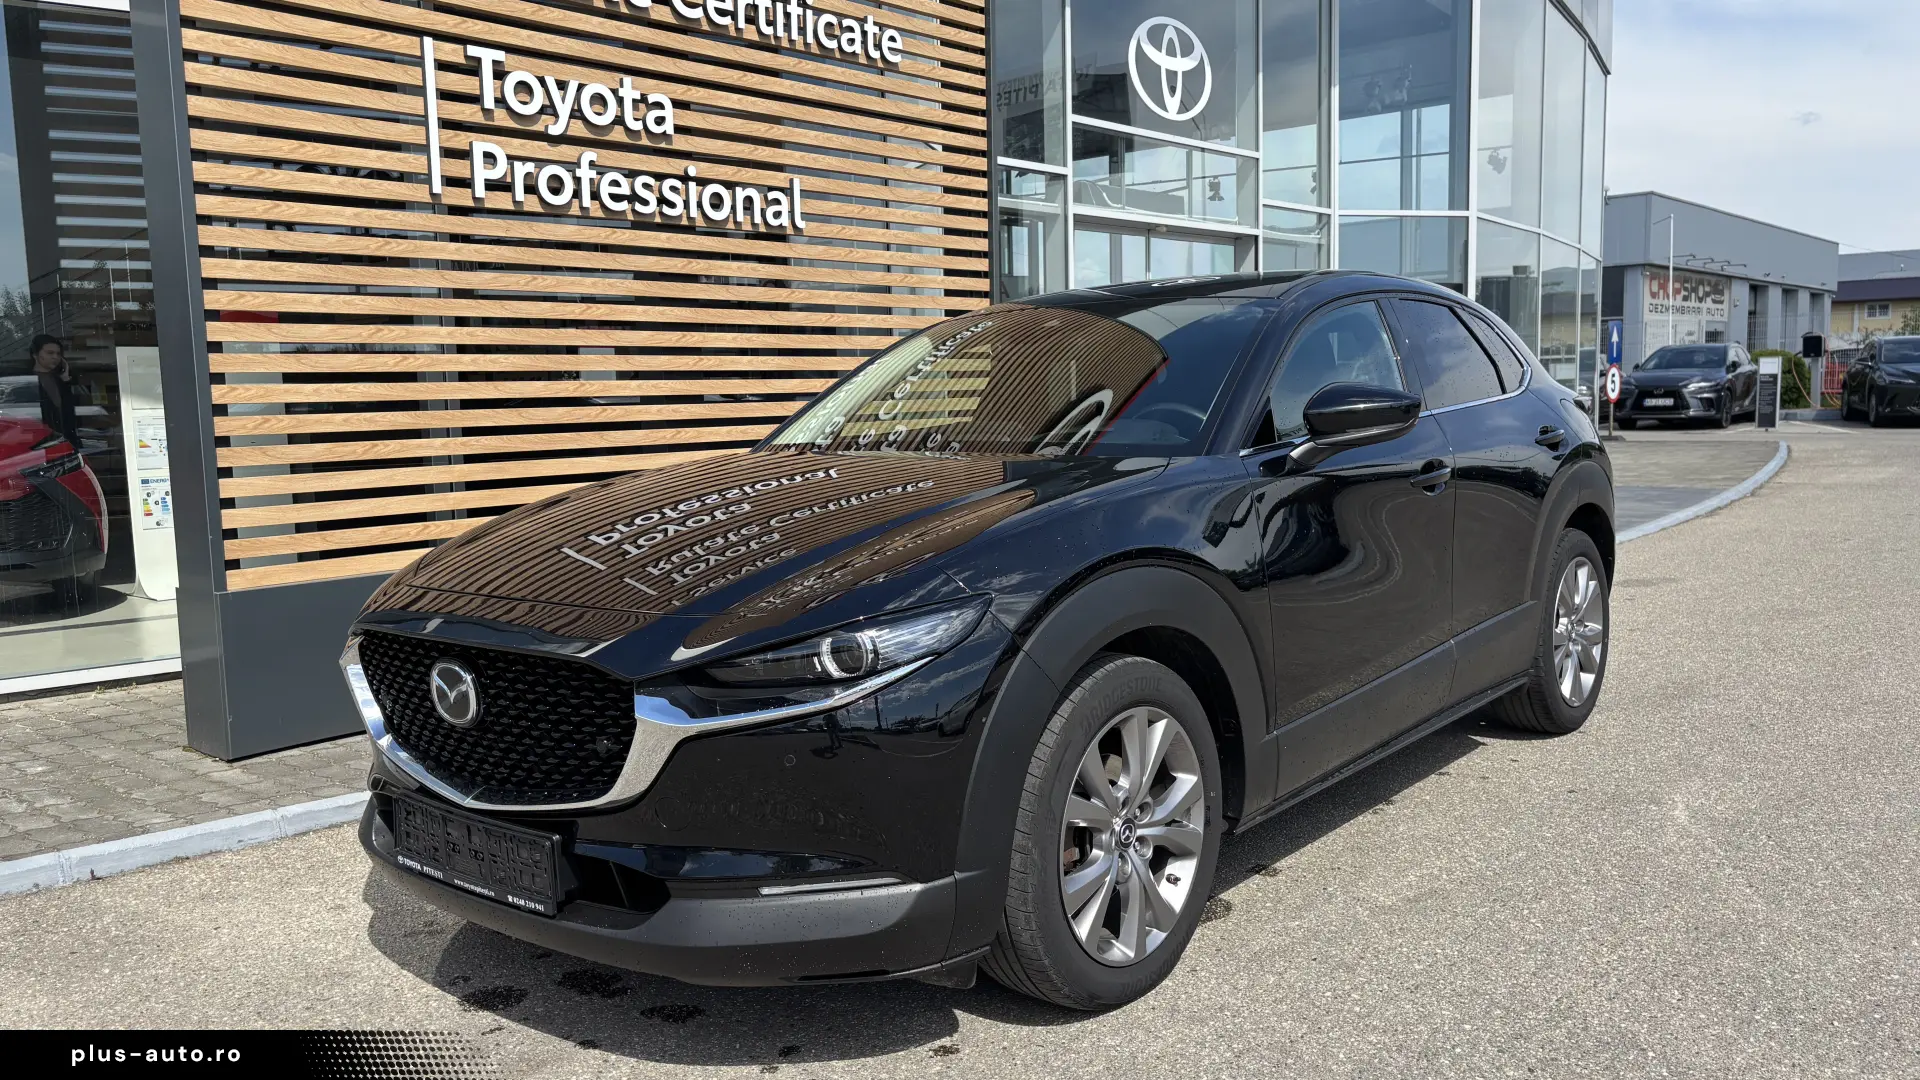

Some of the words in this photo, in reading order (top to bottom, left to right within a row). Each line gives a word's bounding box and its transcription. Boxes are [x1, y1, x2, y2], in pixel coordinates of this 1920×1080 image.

[465, 44, 676, 136] Toyota
[469, 140, 806, 229] Professional
[1705, 307, 1725, 318] AUTO
[1610, 373, 1617, 394] 5
[403, 857, 421, 871] TOYOTA
